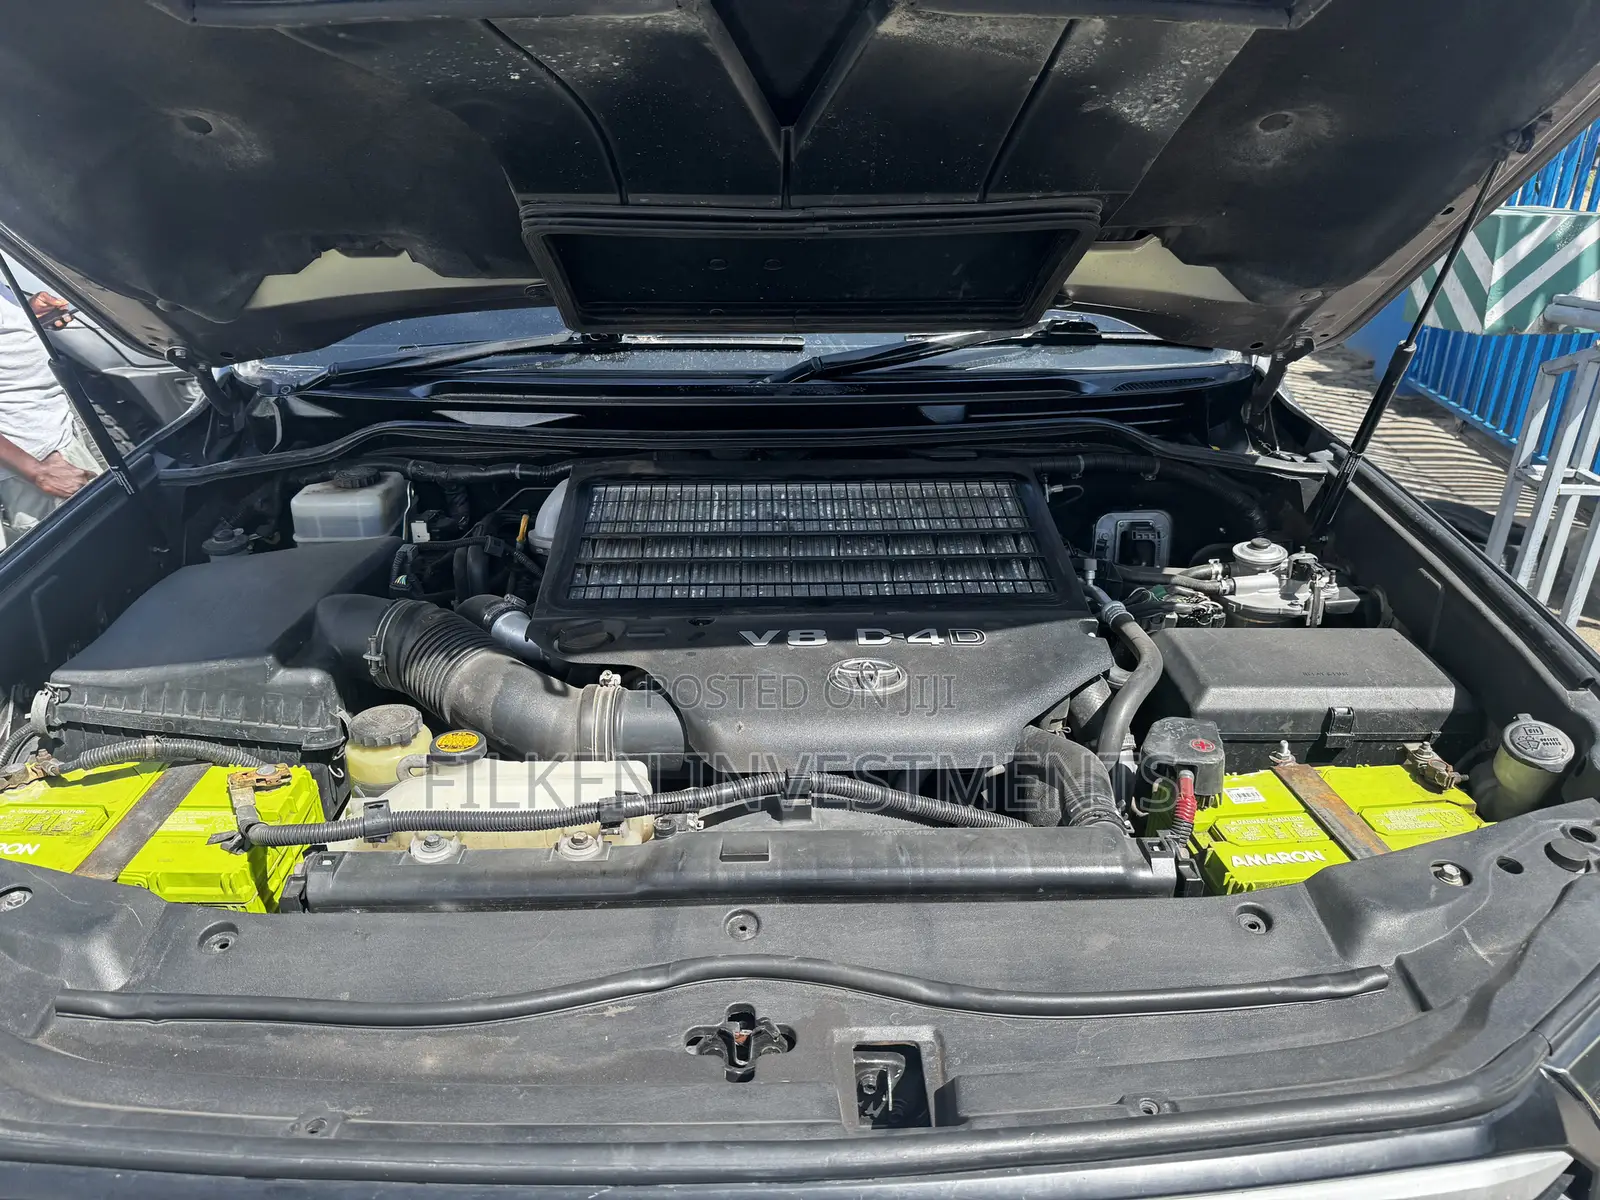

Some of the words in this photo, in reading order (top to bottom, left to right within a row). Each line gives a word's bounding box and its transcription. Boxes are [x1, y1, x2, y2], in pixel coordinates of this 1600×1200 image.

[738, 628, 828, 647] V8
[856, 628, 988, 647] D-4D
[1231, 849, 1327, 868] AMARON
